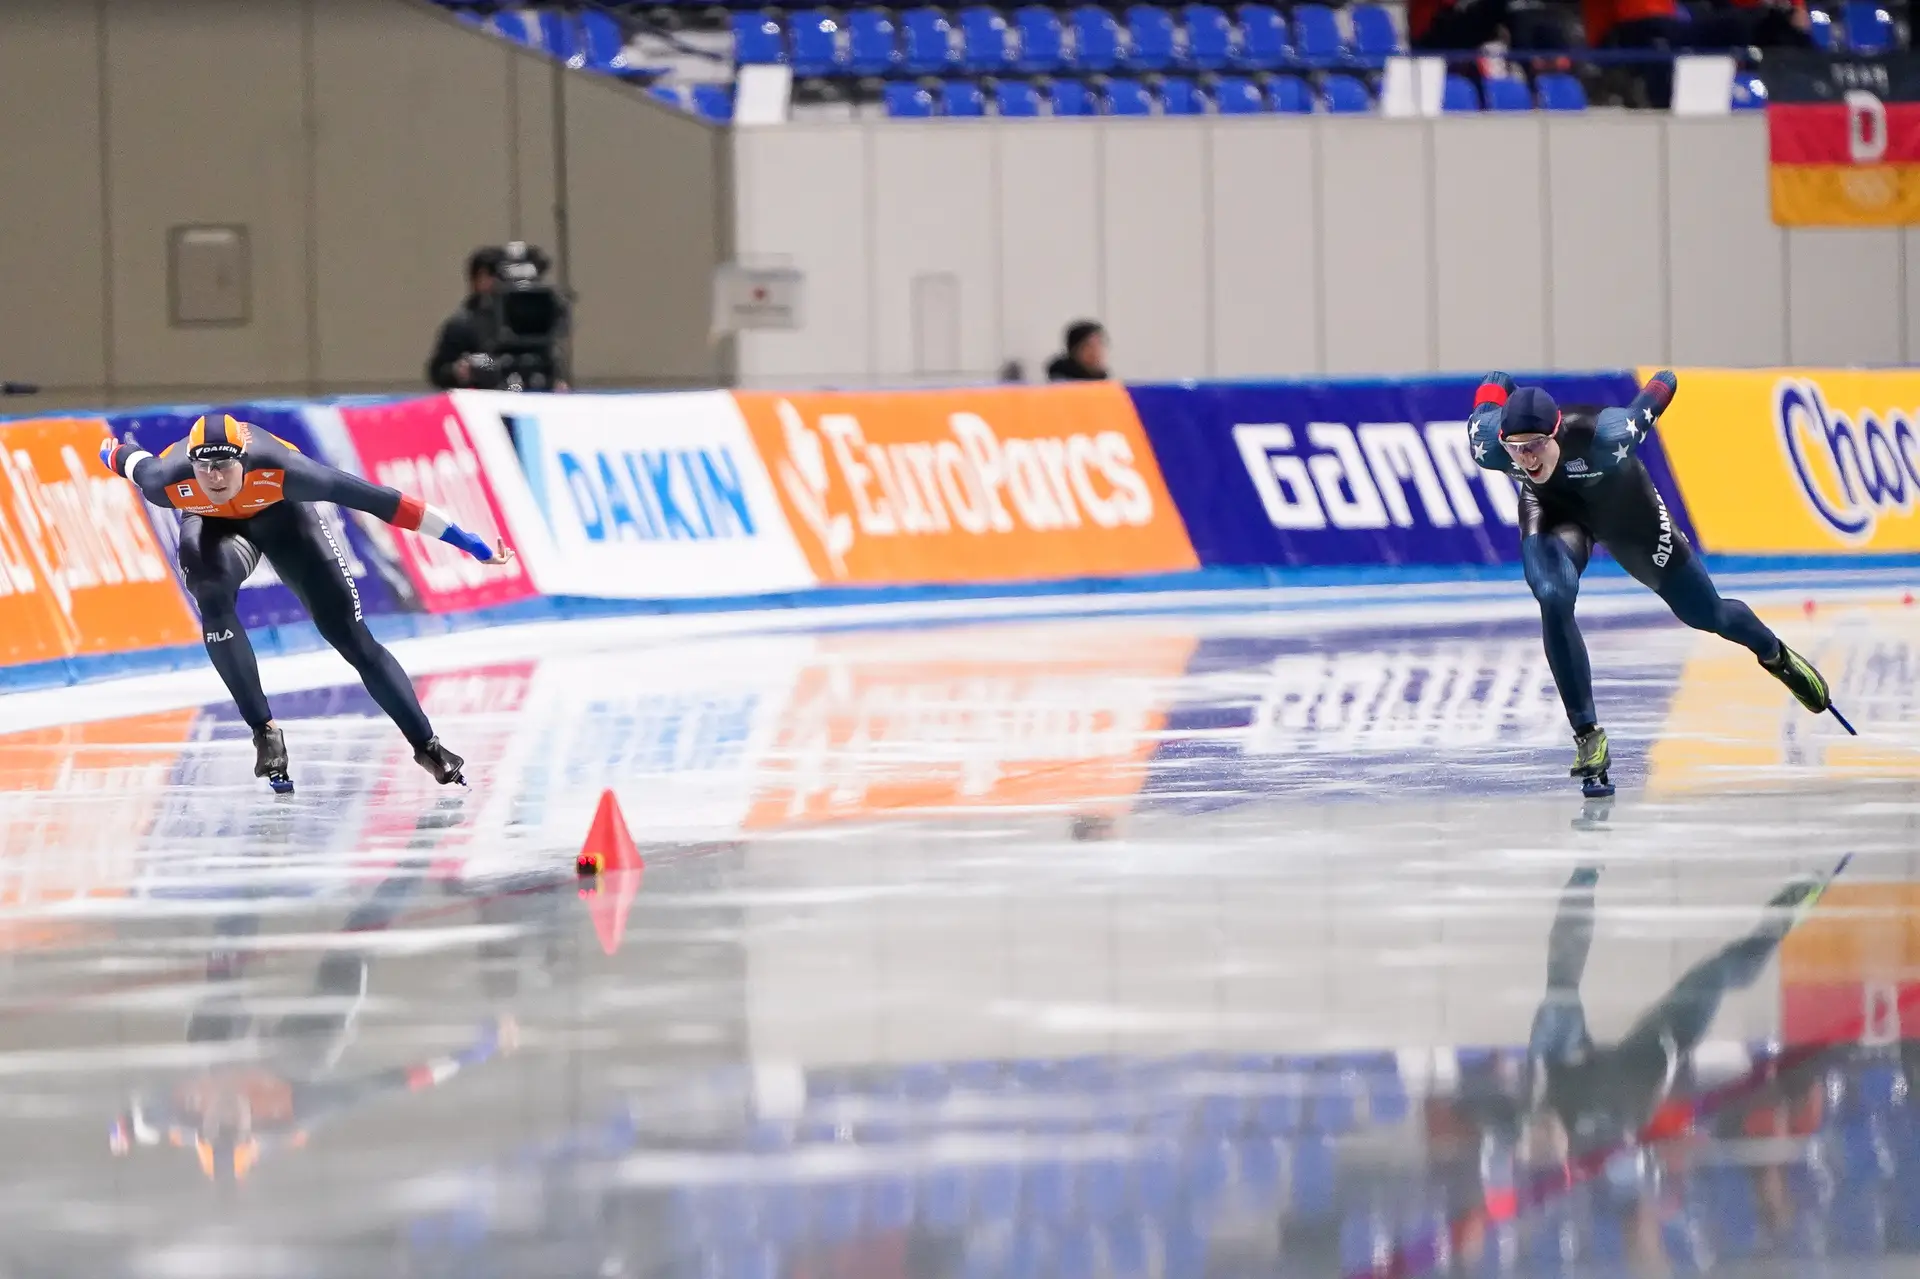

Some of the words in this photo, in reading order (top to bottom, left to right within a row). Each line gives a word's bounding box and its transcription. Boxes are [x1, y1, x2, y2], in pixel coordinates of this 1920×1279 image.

[1844, 89, 1888, 163] D
[203, 445, 238, 454] DAIKIN
[819, 411, 1155, 536] EuroParcs
[558, 445, 755, 540] DAIKIN
[206, 628, 234, 643] FILA
